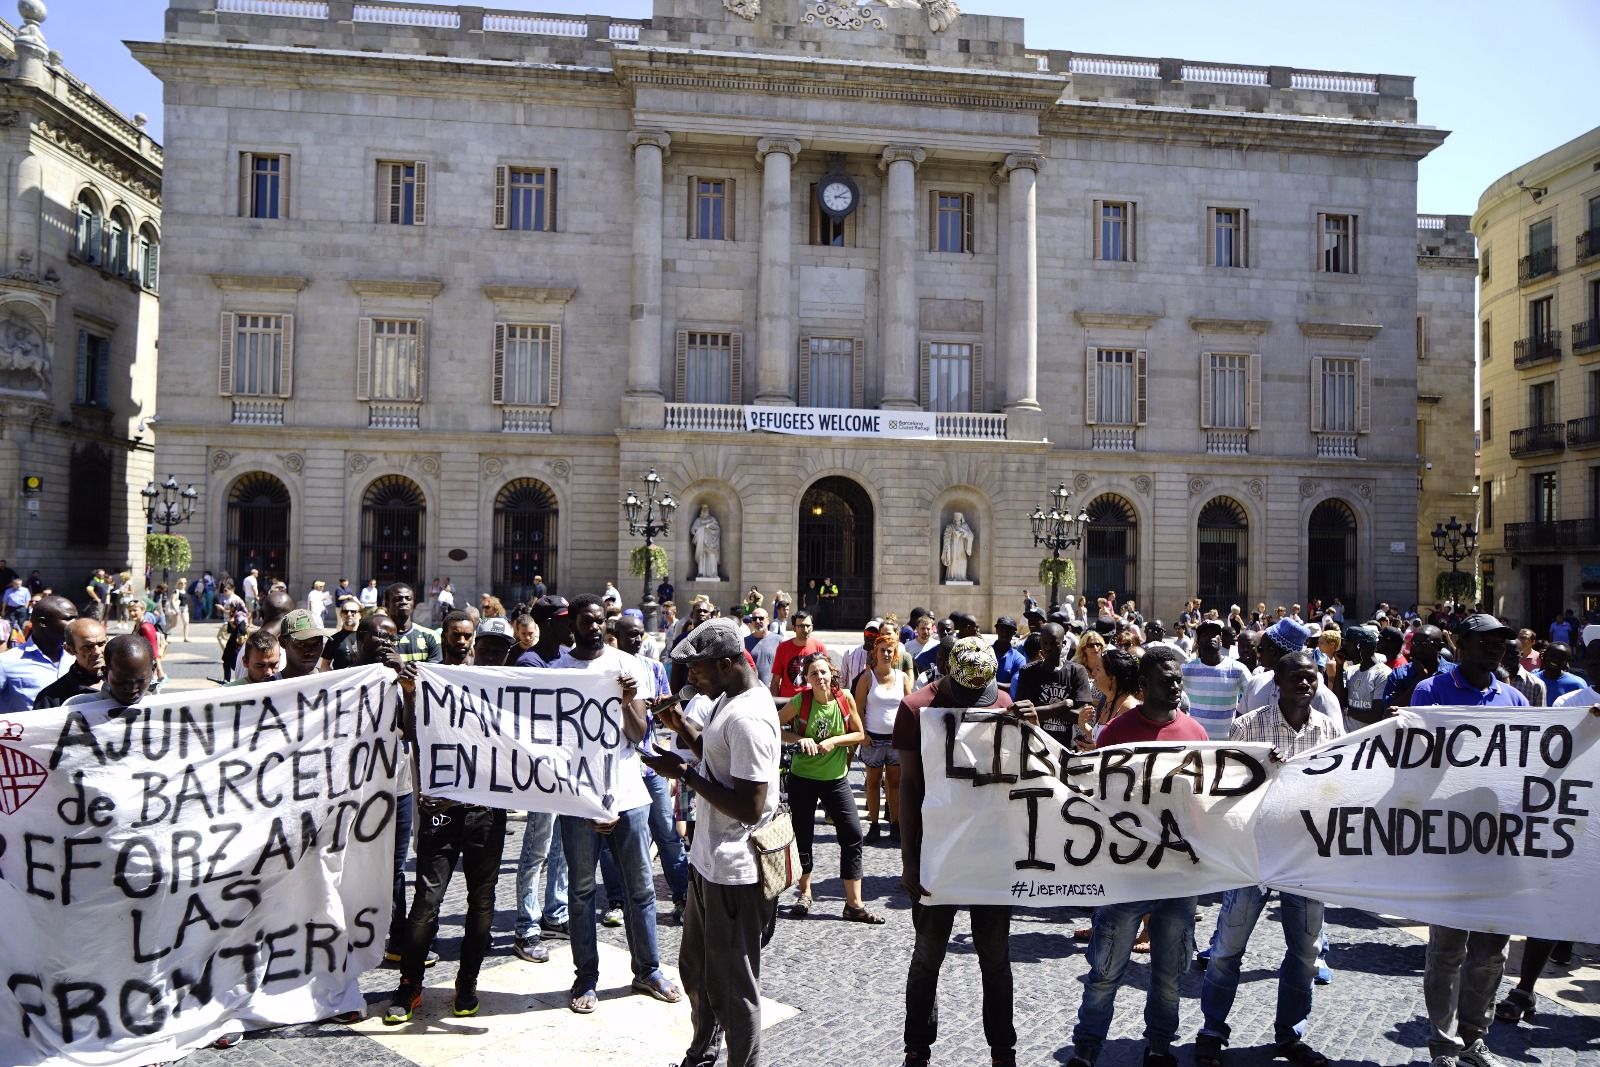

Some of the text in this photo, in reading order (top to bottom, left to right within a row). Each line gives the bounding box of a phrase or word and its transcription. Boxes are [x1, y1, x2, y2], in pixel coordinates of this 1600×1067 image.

[750, 411, 881, 432] REFUGEES WELCOME
[421, 681, 622, 750] MANTEROS
[428, 743, 478, 790] EN
[945, 712, 1267, 805] LIBERTAD
[1302, 723, 1573, 775] SINDICATO
[57, 771, 116, 827] de
[1522, 775, 1593, 816] DE
[0, 790, 395, 905] EFORZANDO
[1008, 787, 1200, 871] ISSA
[1300, 806, 1576, 859] VENDEDORES
[130, 879, 262, 963] LAS
[7, 907, 379, 1044] FRONTERS
